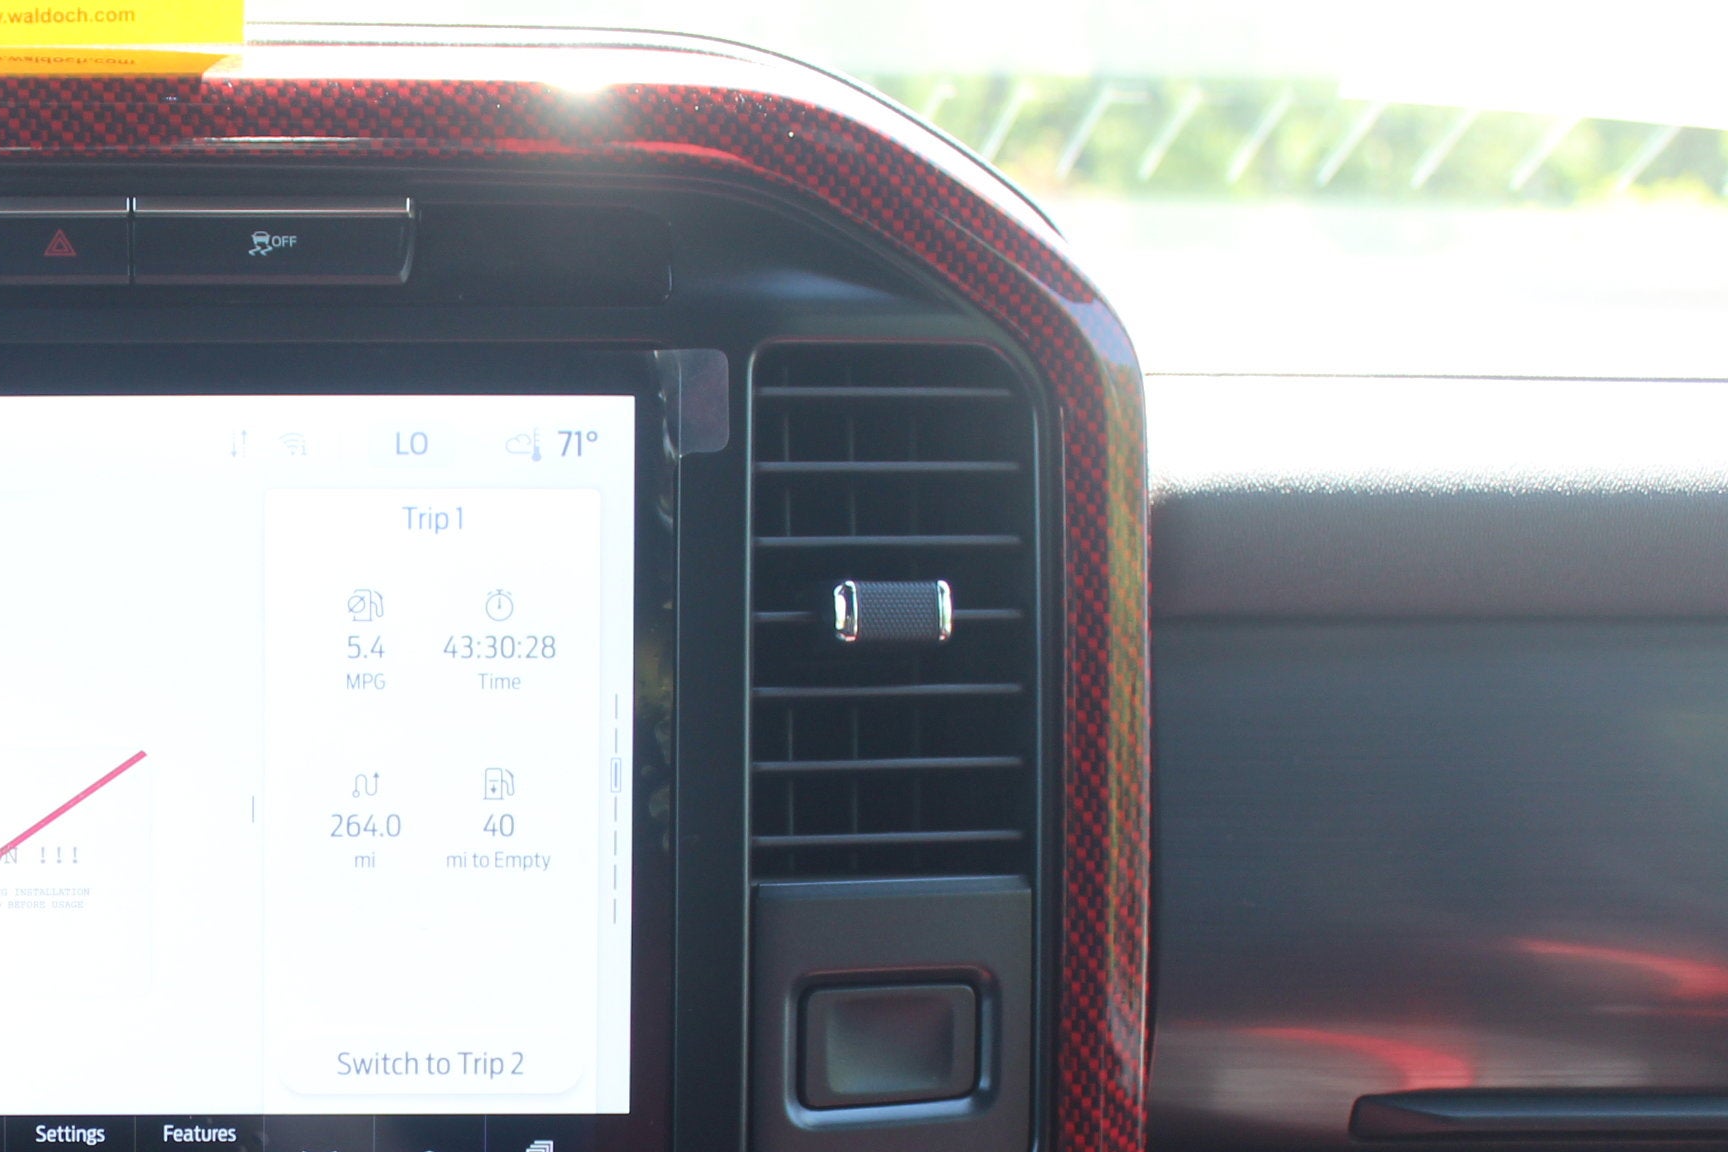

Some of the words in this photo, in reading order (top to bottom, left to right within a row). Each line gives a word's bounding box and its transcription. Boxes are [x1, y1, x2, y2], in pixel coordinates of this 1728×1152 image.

[271, 236, 298, 248] OFF
[395, 431, 429, 455] LO
[557, 430, 599, 457] 71°
[402, 506, 450, 534] Trip
[456, 506, 464, 530] 1
[347, 636, 385, 659] 5.4
[443, 636, 557, 659] 43:30:28
[346, 673, 386, 690] MPG
[478, 673, 521, 690] Time
[330, 814, 402, 837] 264.0
[483, 814, 515, 837] 40
[354, 852, 376, 868] mi
[446, 852, 468, 868] mi
[472, 853, 490, 868] to
[494, 852, 552, 872] Empty
[337, 1052, 419, 1076] Switch
[426, 1055, 450, 1075] to
[457, 1051, 505, 1079] Trip
[510, 1052, 524, 1075] 2
[35, 1124, 105, 1148] Settings
[163, 1124, 237, 1143] Features
